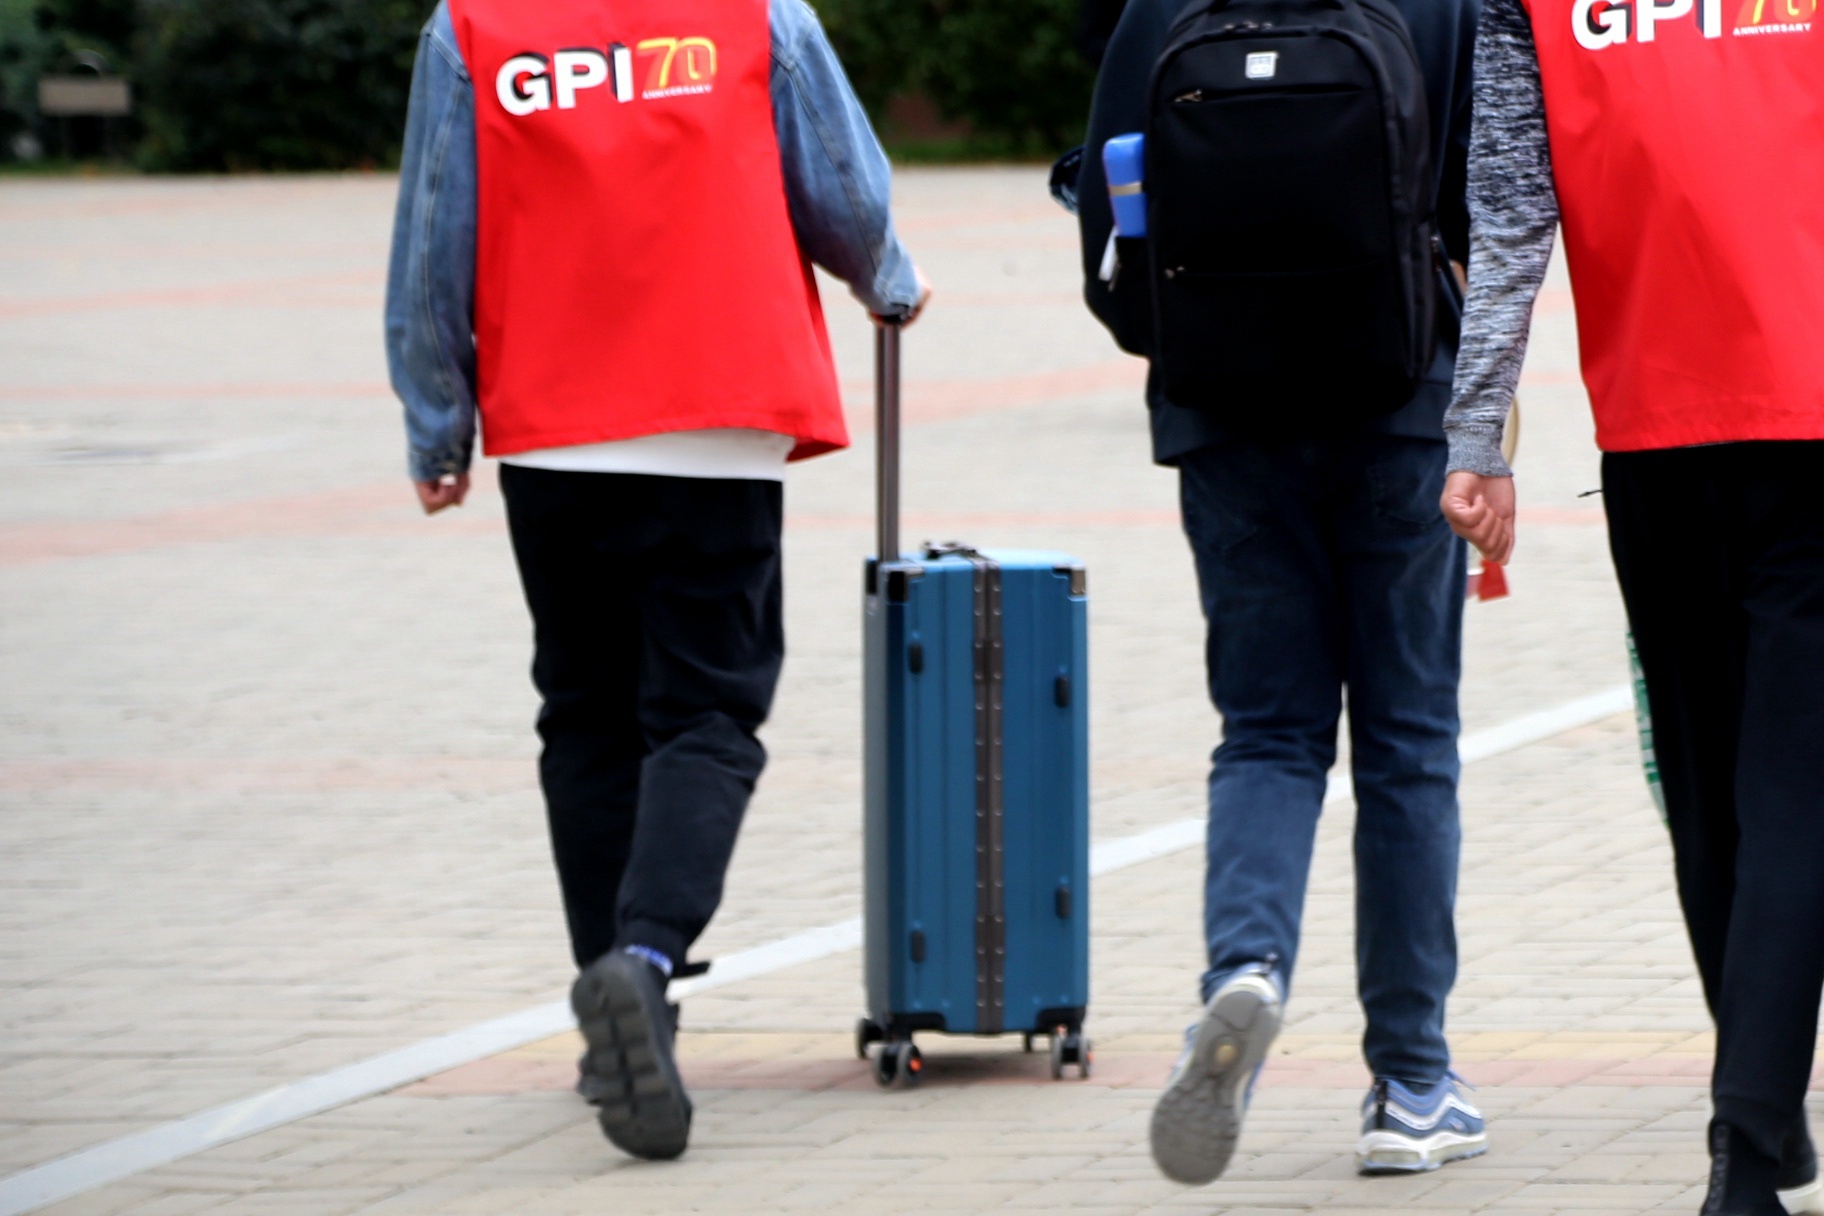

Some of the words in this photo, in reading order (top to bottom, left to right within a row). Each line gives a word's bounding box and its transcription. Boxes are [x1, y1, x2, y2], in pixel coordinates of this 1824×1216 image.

[1732, 21, 1812, 36] ANNIVERSARY
[495, 40, 634, 116] GPI
[636, 36, 717, 89] 70
